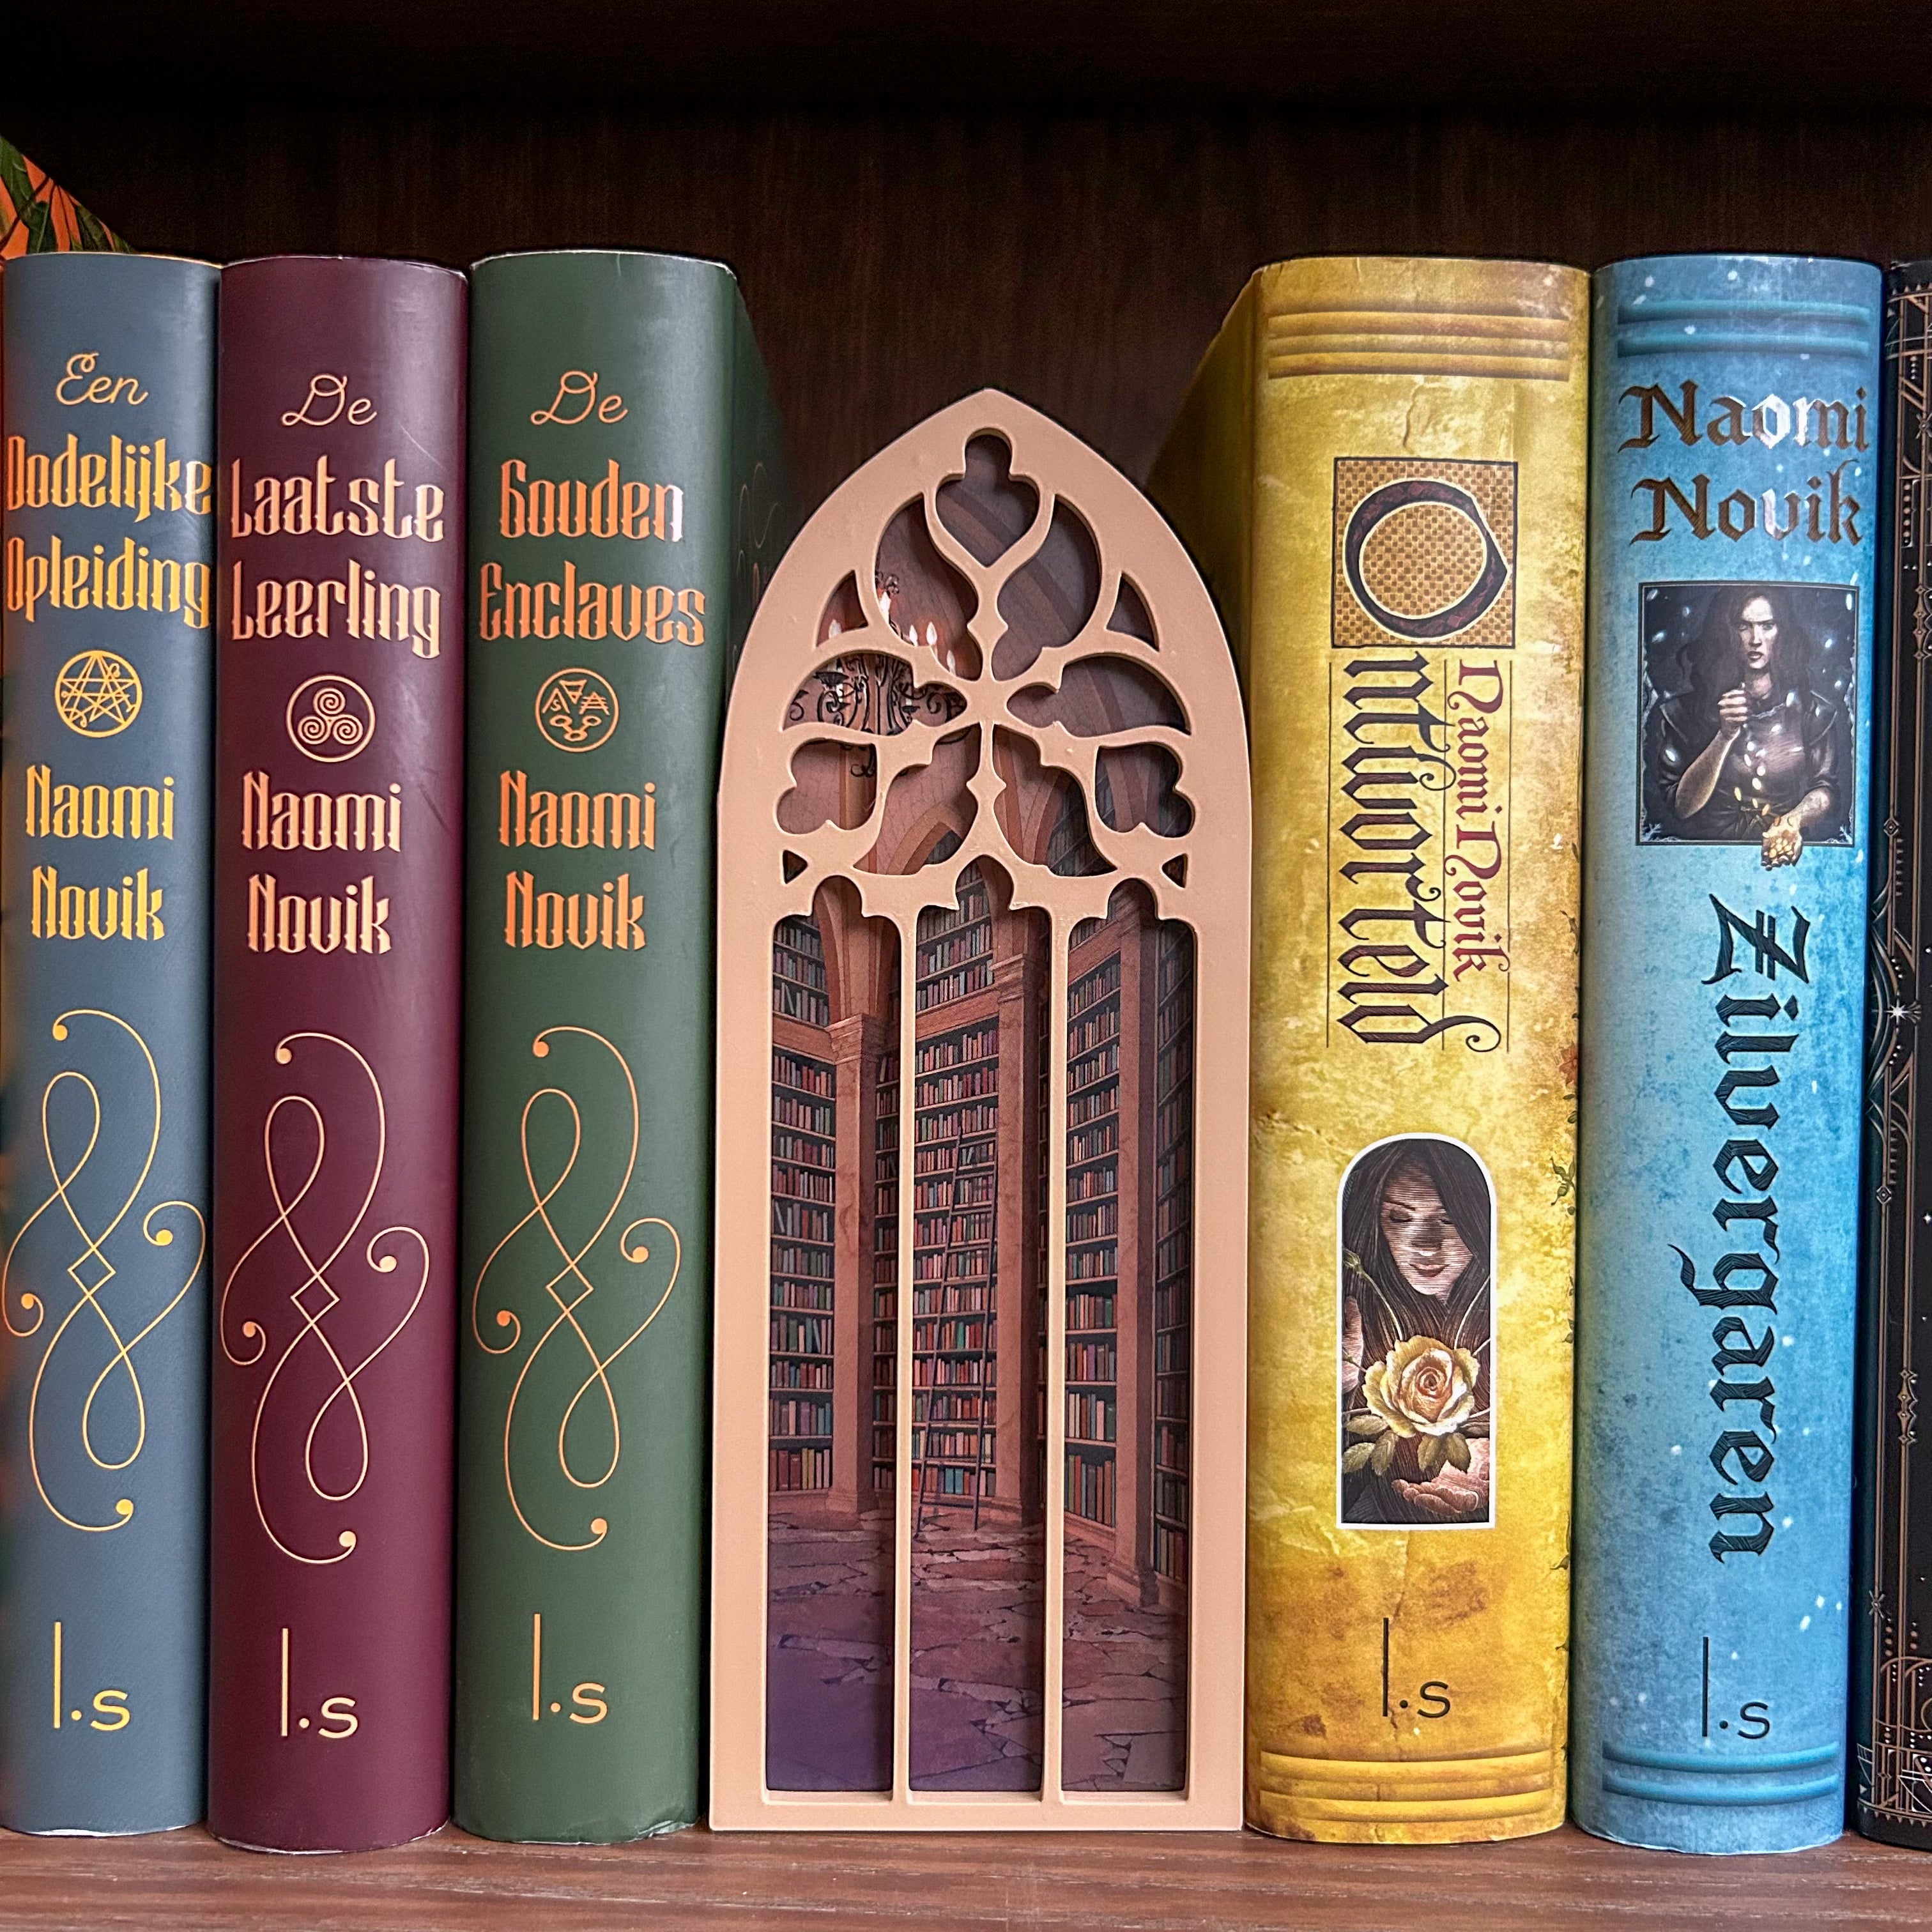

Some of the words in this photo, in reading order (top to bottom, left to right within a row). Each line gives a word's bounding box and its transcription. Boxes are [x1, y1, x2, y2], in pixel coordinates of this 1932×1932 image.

[56, 352, 149, 406] Een
[281, 374, 377, 426] De
[531, 371, 628, 425] De
[1617, 379, 1869, 454] Naomi
[7, 433, 211, 523] Dodelijke
[231, 455, 445, 542] Laatste
[499, 459, 684, 542] Gouden
[1629, 459, 1863, 546] Novik
[7, 535, 211, 629] Opleiding
[231, 560, 441, 659] Leerling
[479, 560, 705, 647] Enclaves
[1337, 476, 1509, 1052] Ontworteld
[1447, 659, 1503, 820] Naomi
[26, 765, 174, 840] Naomi
[241, 770, 401, 852] Naomi
[499, 770, 656, 850] Naomi
[31, 866, 165, 940] Novik
[247, 873, 391, 954] Novik
[505, 871, 646, 950] Novik
[1444, 821, 1510, 981] Novik
[1667, 894, 1810, 1563] Zilvergaren
